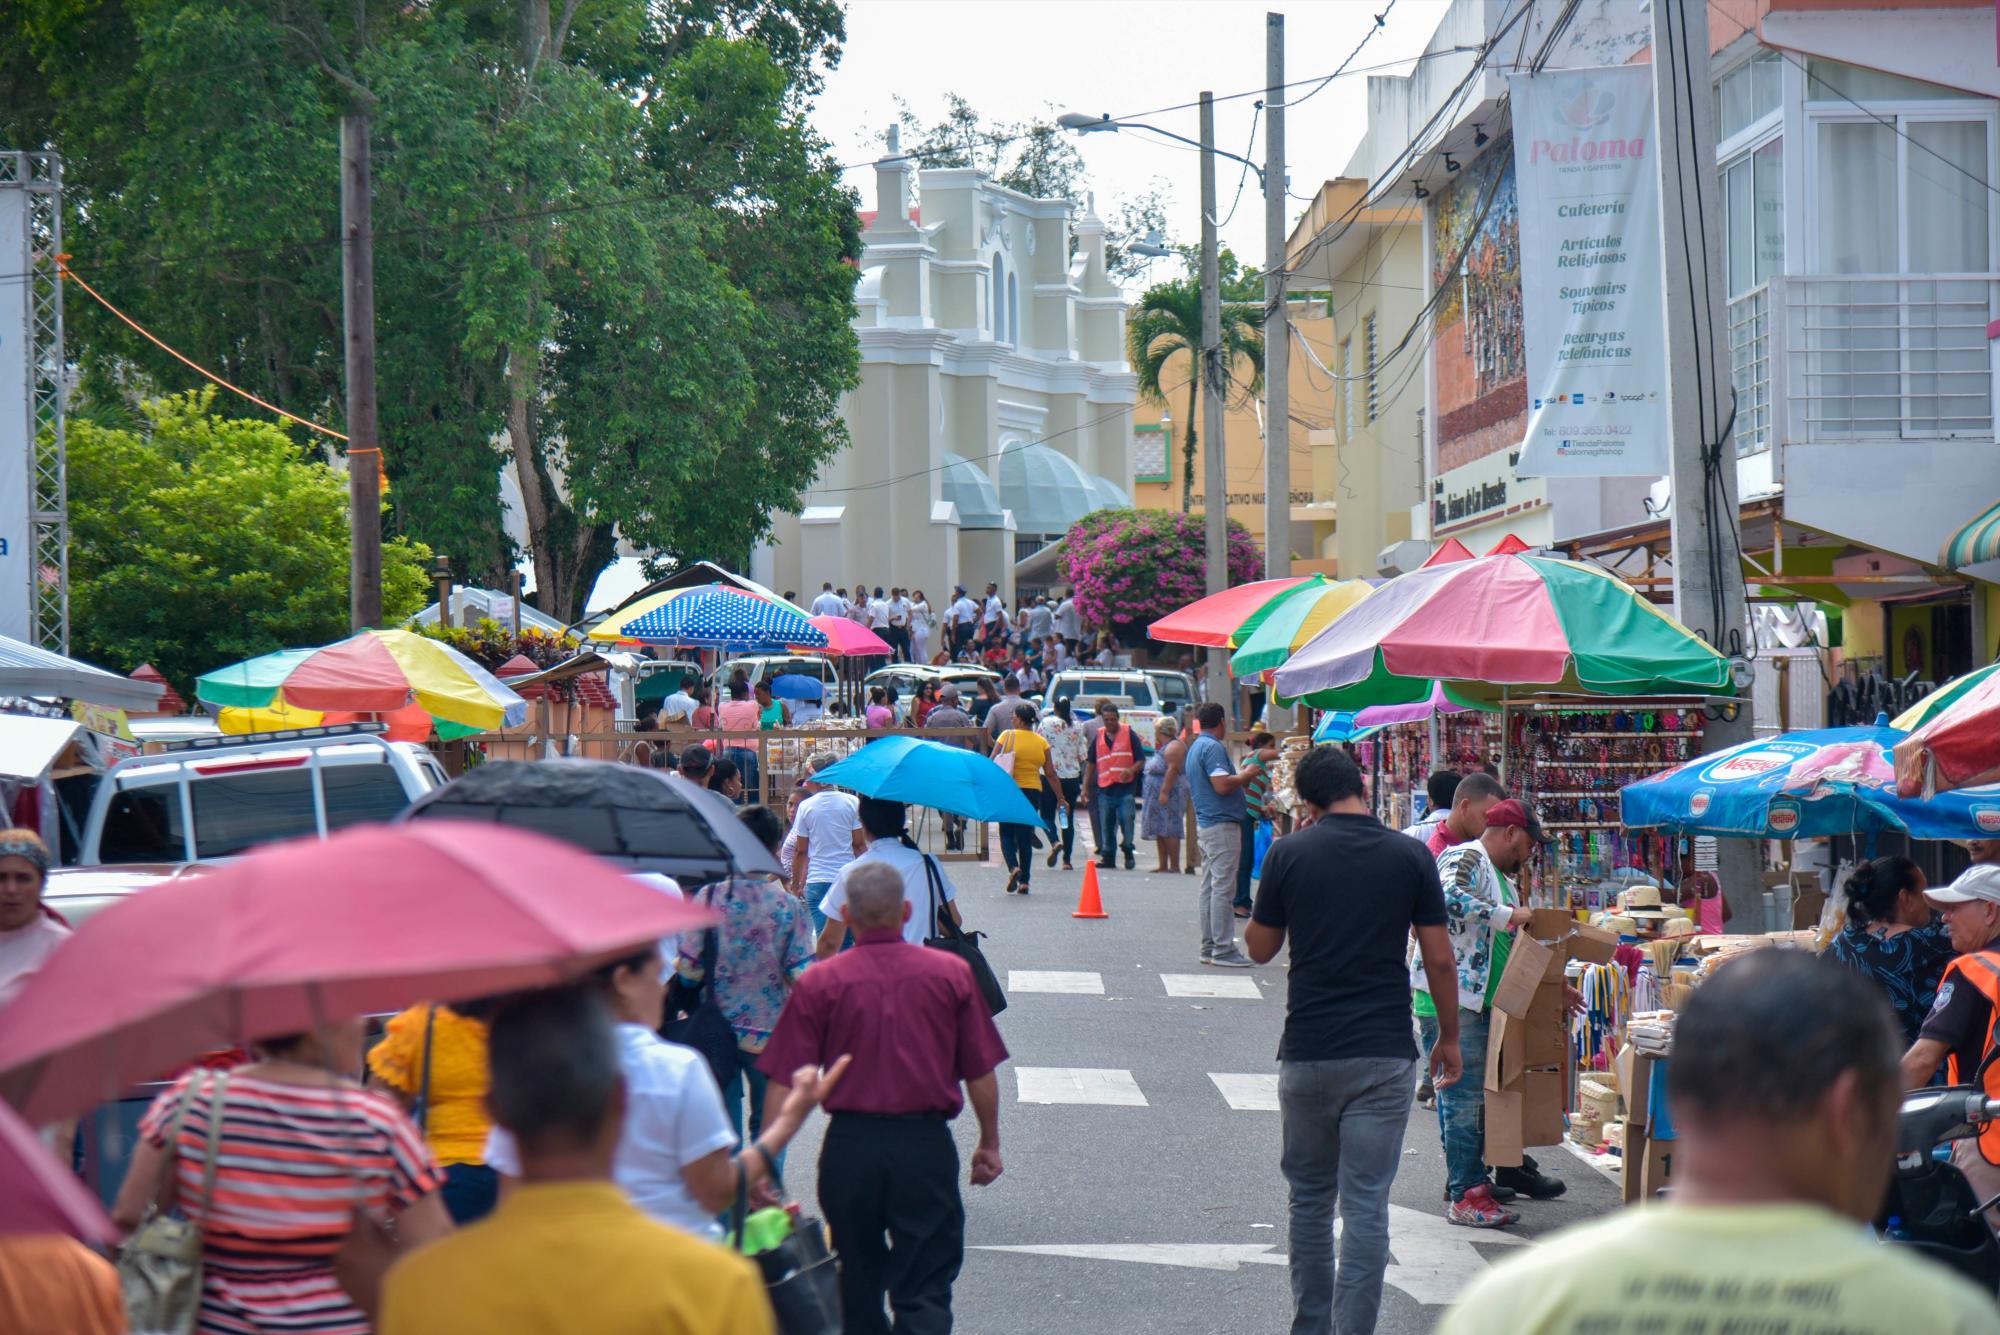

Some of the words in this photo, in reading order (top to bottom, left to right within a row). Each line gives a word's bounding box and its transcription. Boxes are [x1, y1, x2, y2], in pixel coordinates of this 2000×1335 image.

[1529, 136, 1645, 166] Paloma
[1558, 200, 1625, 217] Cafetería
[1560, 234, 1622, 251] Artículos
[1558, 252, 1627, 268] Religiosos
[1560, 282, 1627, 299] Souvenirs
[1572, 300, 1615, 314] Típicos
[1563, 331, 1625, 345] Recargas
[1558, 346, 1632, 361] Telefónicas
[1225, 493, 1250, 506] CATIVO
